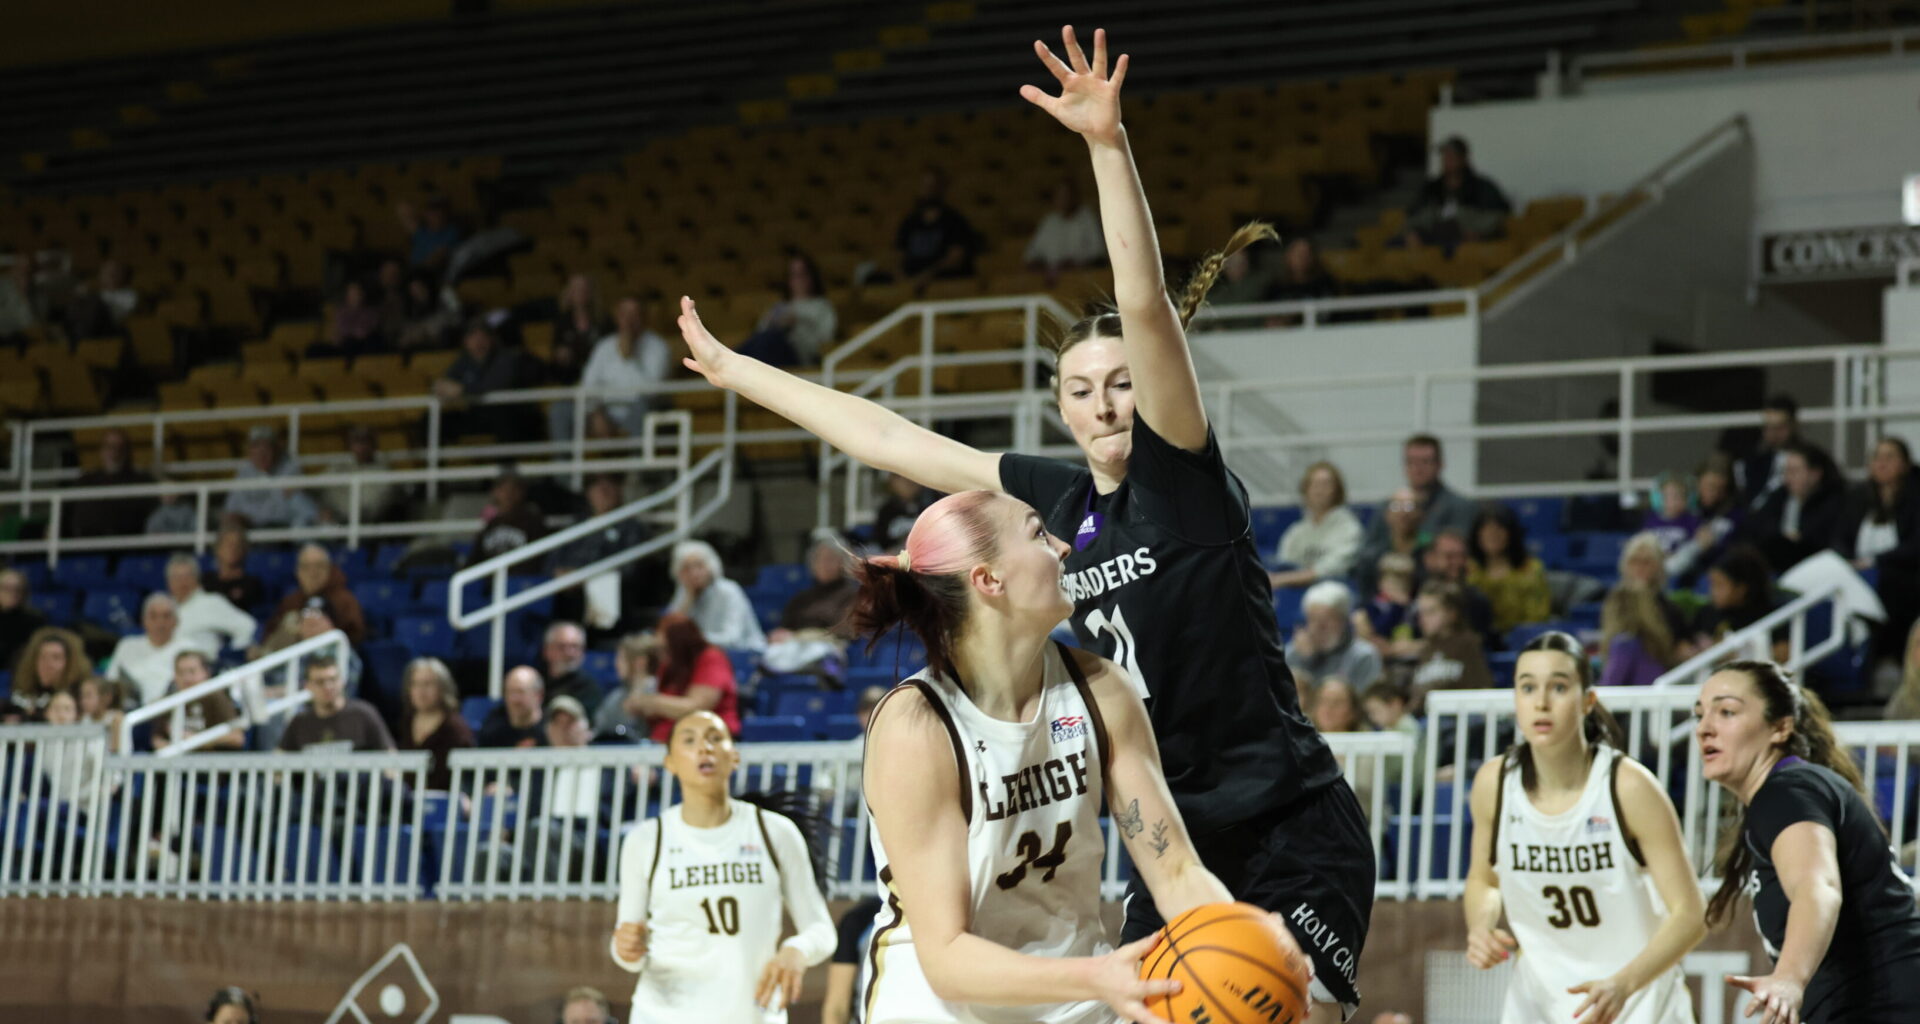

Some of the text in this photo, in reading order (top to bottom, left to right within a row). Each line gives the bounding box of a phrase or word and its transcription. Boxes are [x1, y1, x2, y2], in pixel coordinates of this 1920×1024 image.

[1062, 547, 1157, 602] RUSADERS
[980, 750, 1087, 821] LEHIGH
[669, 862, 763, 890] LEHIGH
[996, 821, 1072, 890] 34
[1511, 841, 1614, 873] LEHIGH
[700, 896, 740, 936] 10
[1290, 902, 1340, 953] HOLY
[1542, 885, 1602, 929] 30
